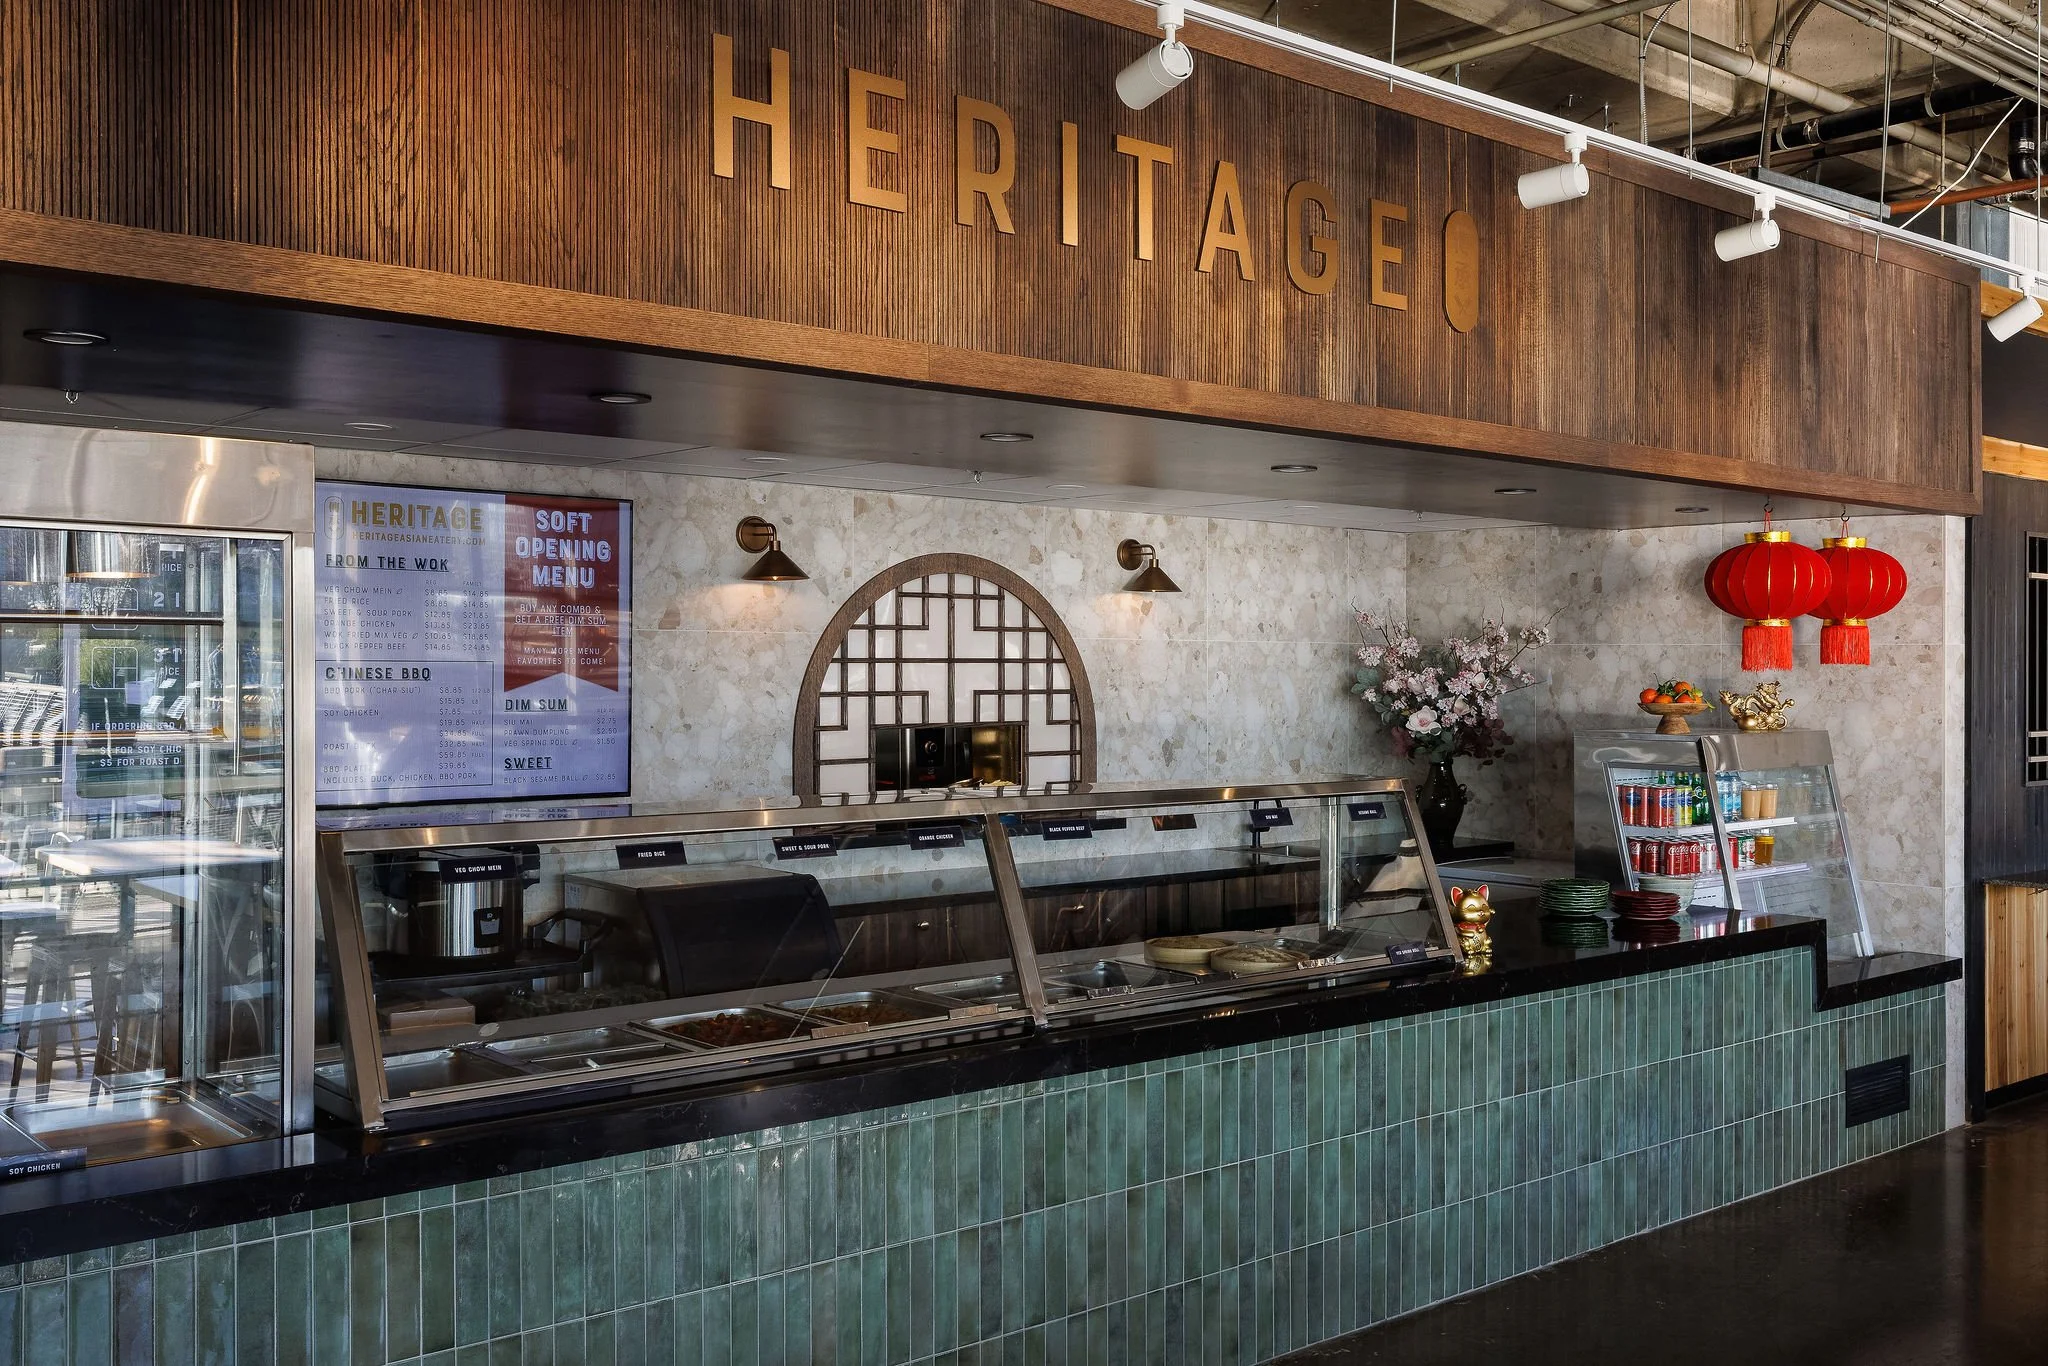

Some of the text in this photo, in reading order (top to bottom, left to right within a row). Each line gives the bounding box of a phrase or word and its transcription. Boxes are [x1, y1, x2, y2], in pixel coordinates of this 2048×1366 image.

[713, 33, 1408, 310] HERITAGE
[351, 501, 484, 533] HERITAGE
[536, 510, 592, 533] SOFT
[352, 532, 486, 546] HERITAGEASIANEATERY.COM
[516, 537, 612, 562] OPENING
[326, 554, 448, 570] FROM THE WOK
[533, 565, 595, 588] MENU
[520, 604, 537, 612] BUY
[540, 605, 557, 613] ANY
[515, 615, 531, 623] GET
[536, 615, 541, 623] A
[544, 616, 564, 624] FREE
[568, 616, 584, 624] DIM
[402, 668, 431, 681] BBQ
[505, 699, 567, 710] DIM SUM
[504, 757, 552, 769] SWEET
[27, 1162, 61, 1173] CHICKEN
